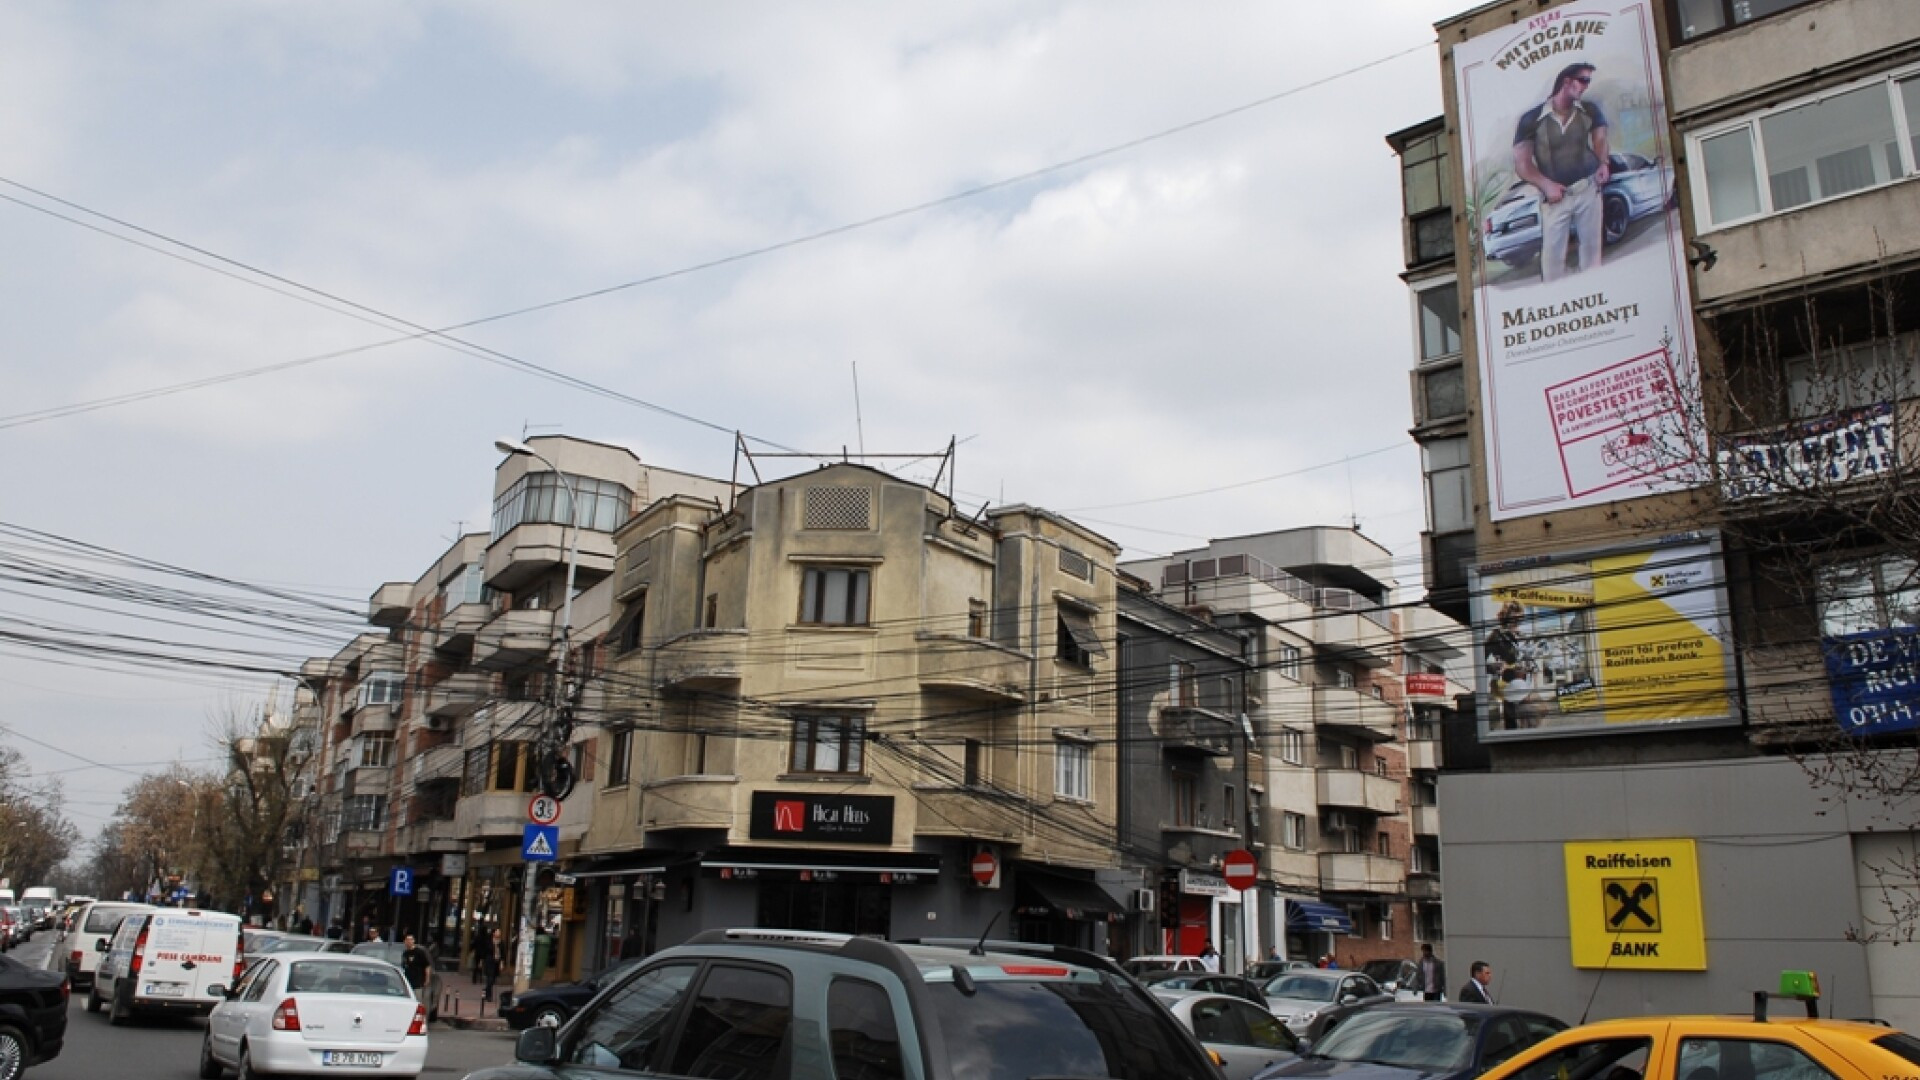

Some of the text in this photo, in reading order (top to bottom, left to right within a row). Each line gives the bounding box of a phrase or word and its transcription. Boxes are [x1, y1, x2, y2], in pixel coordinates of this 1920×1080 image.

[1503, 331, 1527, 348] DE
[1848, 640, 1889, 666] DE
[1606, 655, 1666, 668] Raiffeisen
[1585, 853, 1672, 869] Raiffeisen
[157, 952, 179, 961] PIESE
[1610, 942, 1660, 957] BANK
